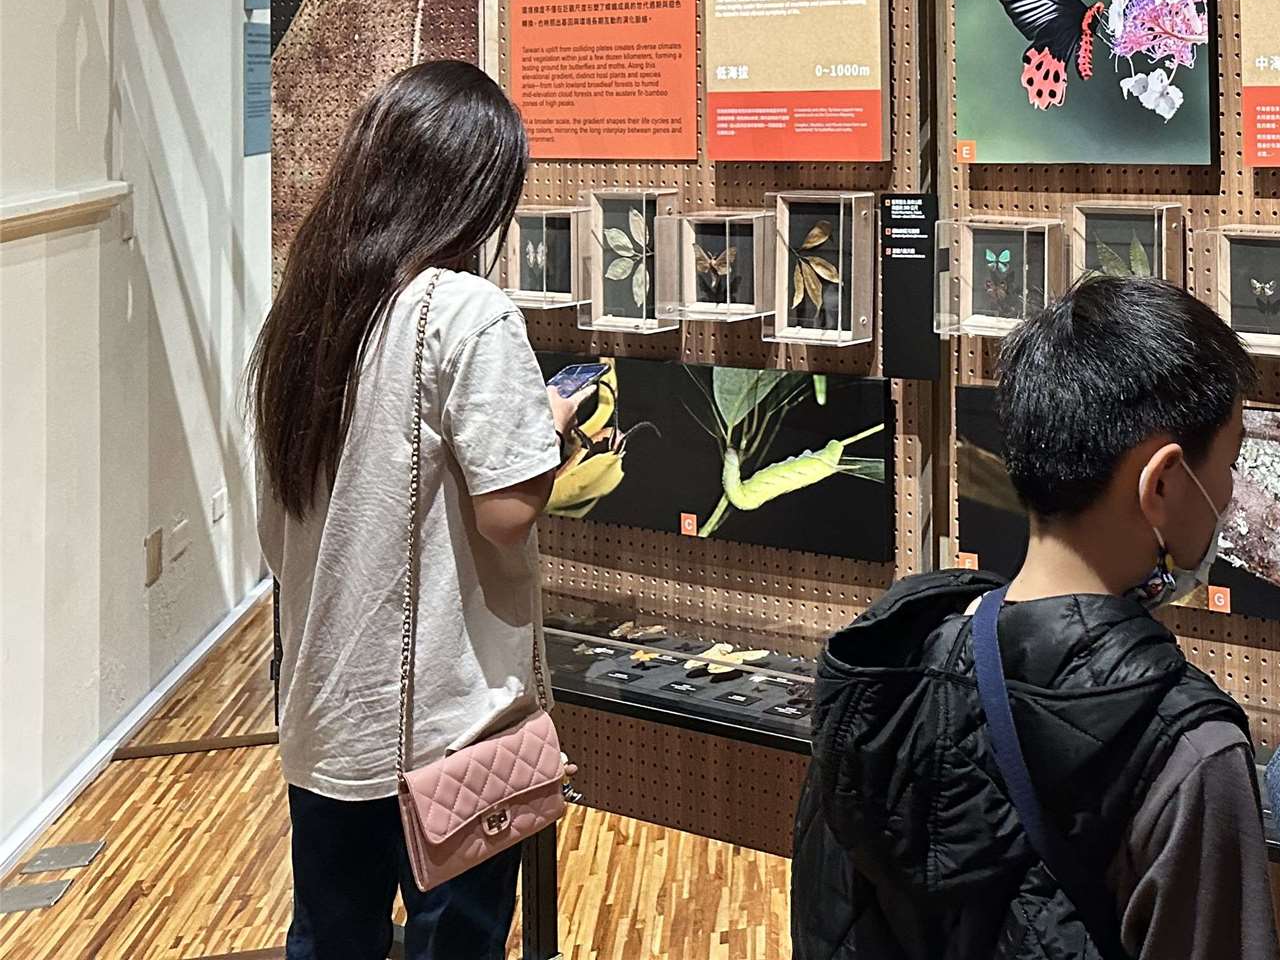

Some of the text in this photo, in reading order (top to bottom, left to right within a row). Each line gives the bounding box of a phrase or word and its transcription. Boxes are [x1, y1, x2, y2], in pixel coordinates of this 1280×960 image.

[716, 65, 749, 80] 低海拔
[815, 63, 870, 77] 0~1000m
[962, 146, 971, 158] E
[685, 518, 693, 530] C
[1214, 593, 1225, 606] G
